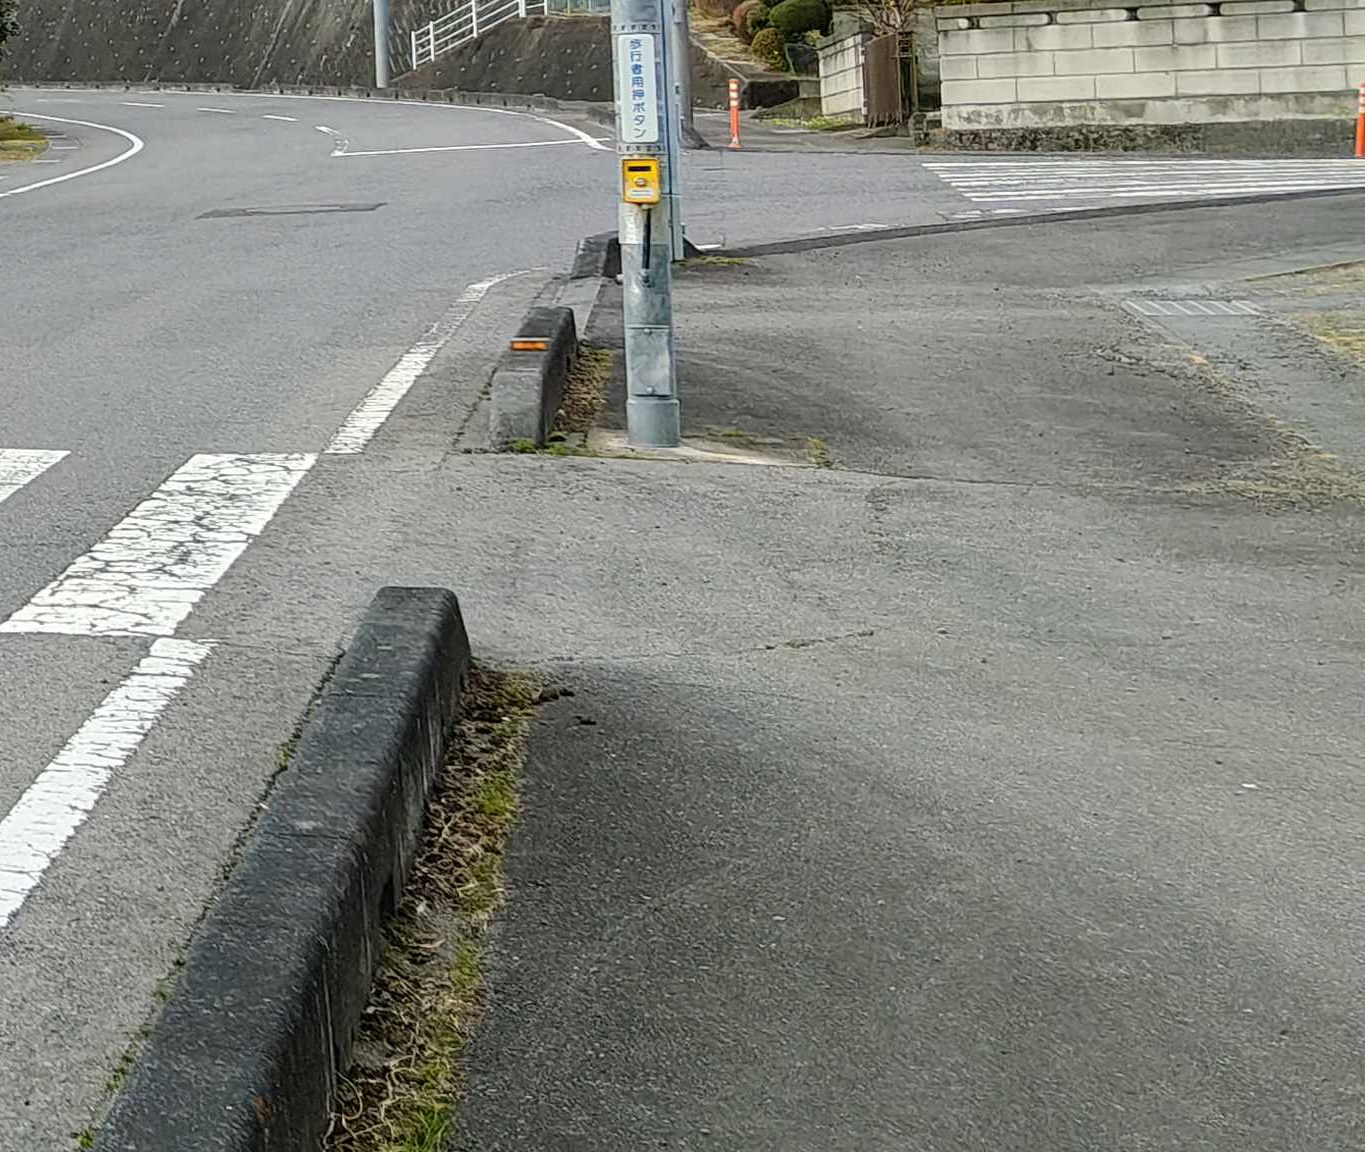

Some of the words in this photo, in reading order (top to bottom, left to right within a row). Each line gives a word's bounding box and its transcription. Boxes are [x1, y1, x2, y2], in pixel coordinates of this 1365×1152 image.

[629, 38, 647, 139] 歩行者用押ボタン
